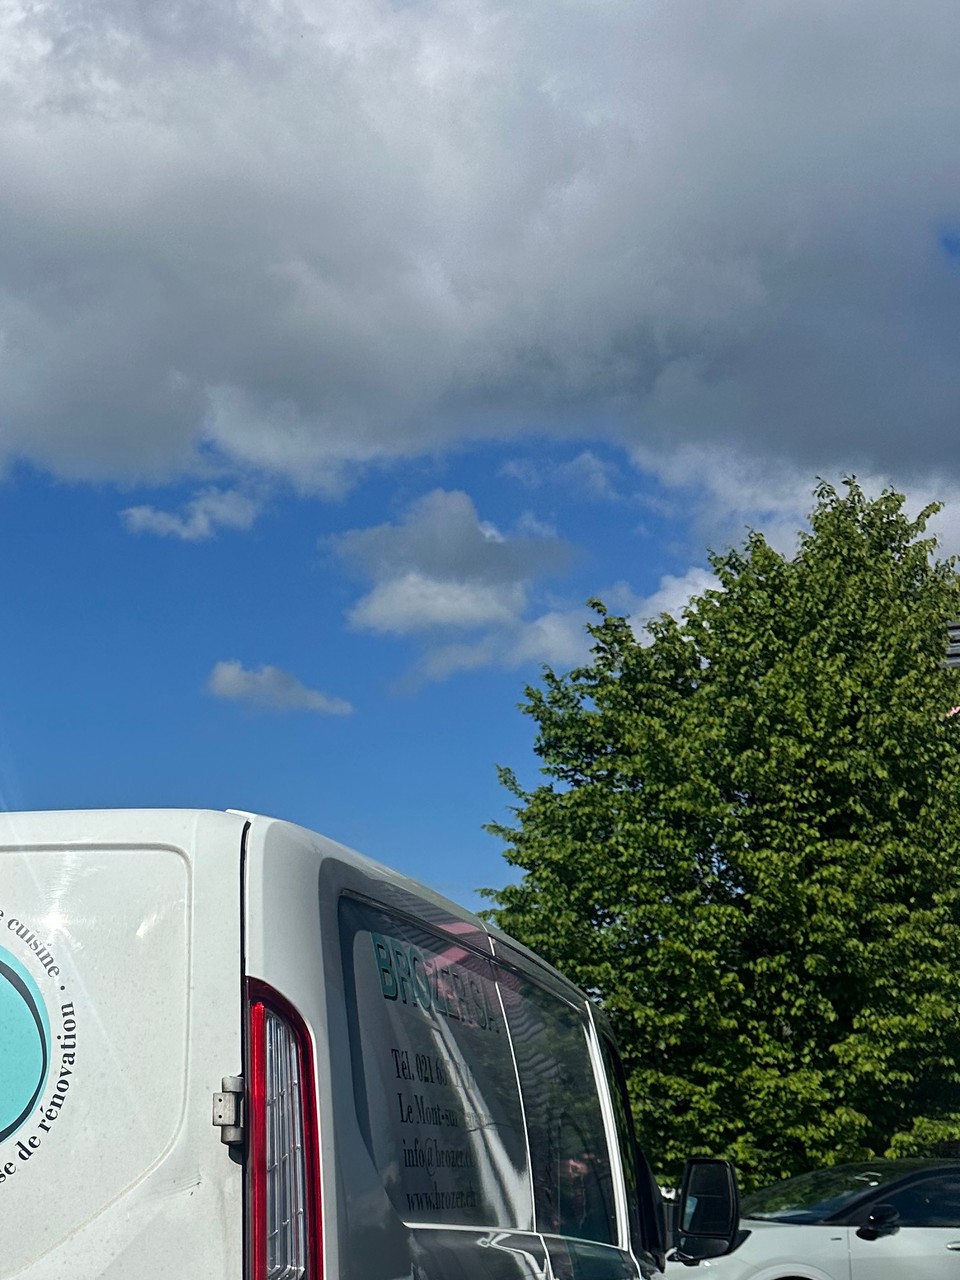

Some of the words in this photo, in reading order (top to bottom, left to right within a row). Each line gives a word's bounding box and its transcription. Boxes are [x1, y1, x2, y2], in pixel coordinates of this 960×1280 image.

[7, 918, 60, 978] cuisine
[14, 1135, 41, 1162] de
[38, 1001, 77, 1133] rénovation
[397, 1092, 414, 1124] Le
